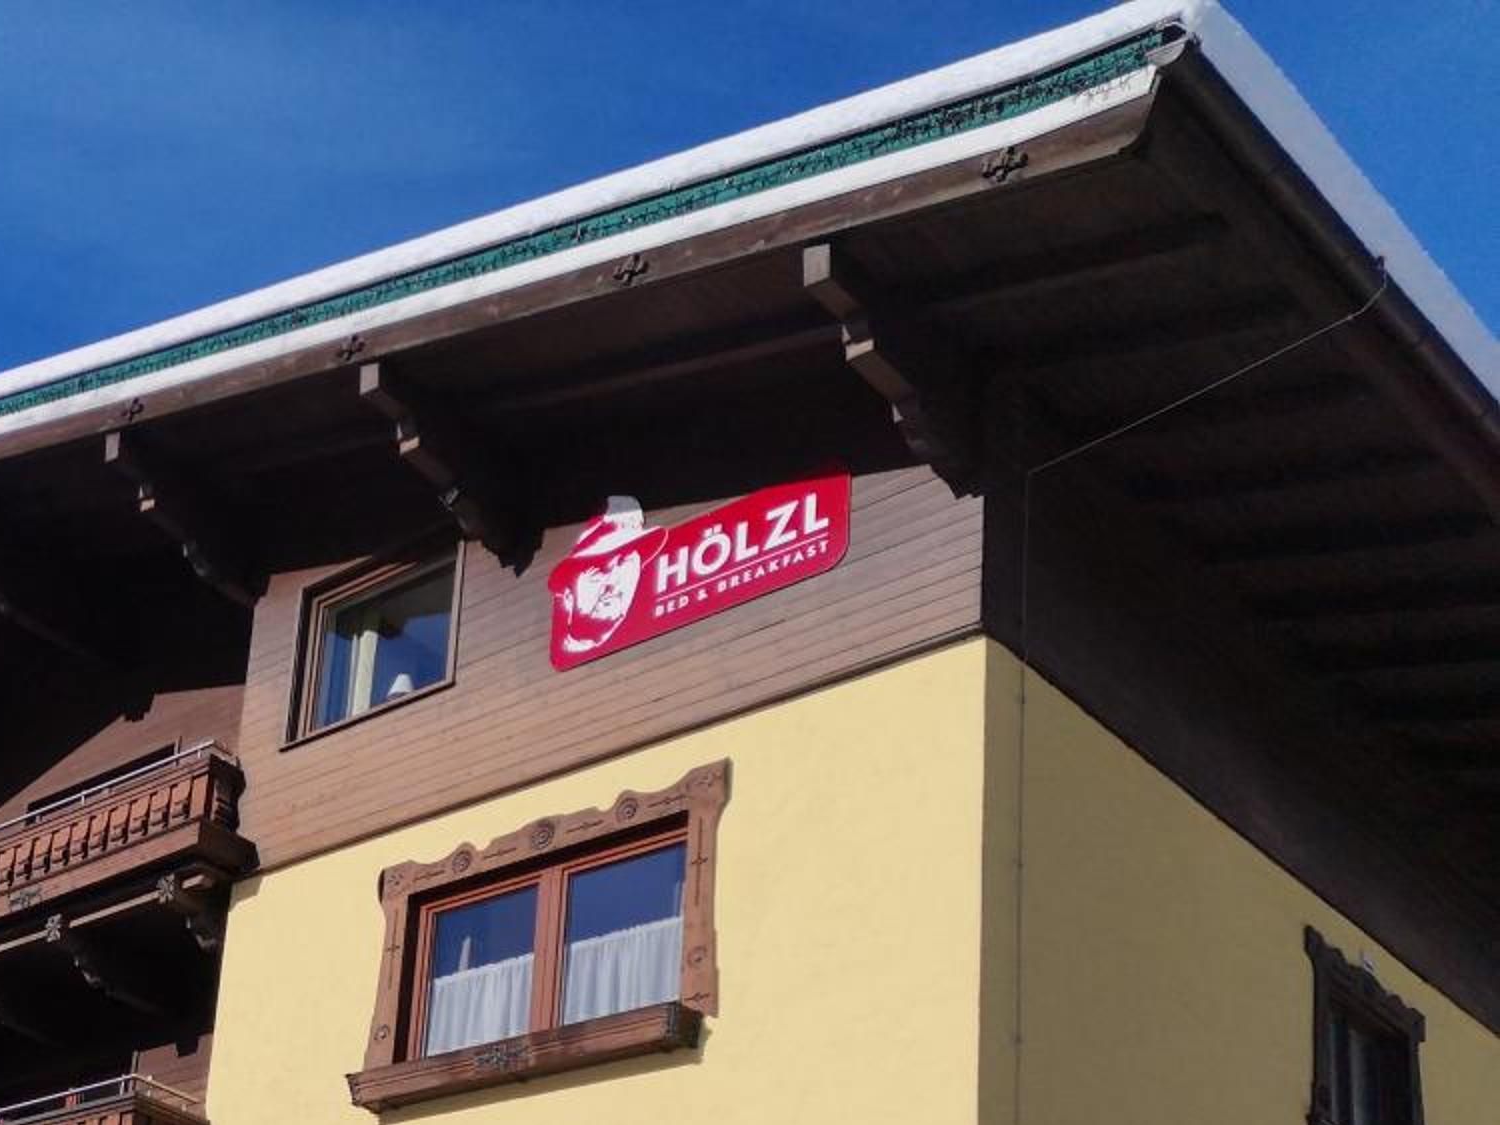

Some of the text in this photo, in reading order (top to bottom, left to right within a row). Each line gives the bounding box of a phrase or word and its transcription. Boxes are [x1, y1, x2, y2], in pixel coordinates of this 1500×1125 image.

[655, 540, 829, 617] BED & BREAKFAST
[657, 493, 829, 593] HÖLZL
